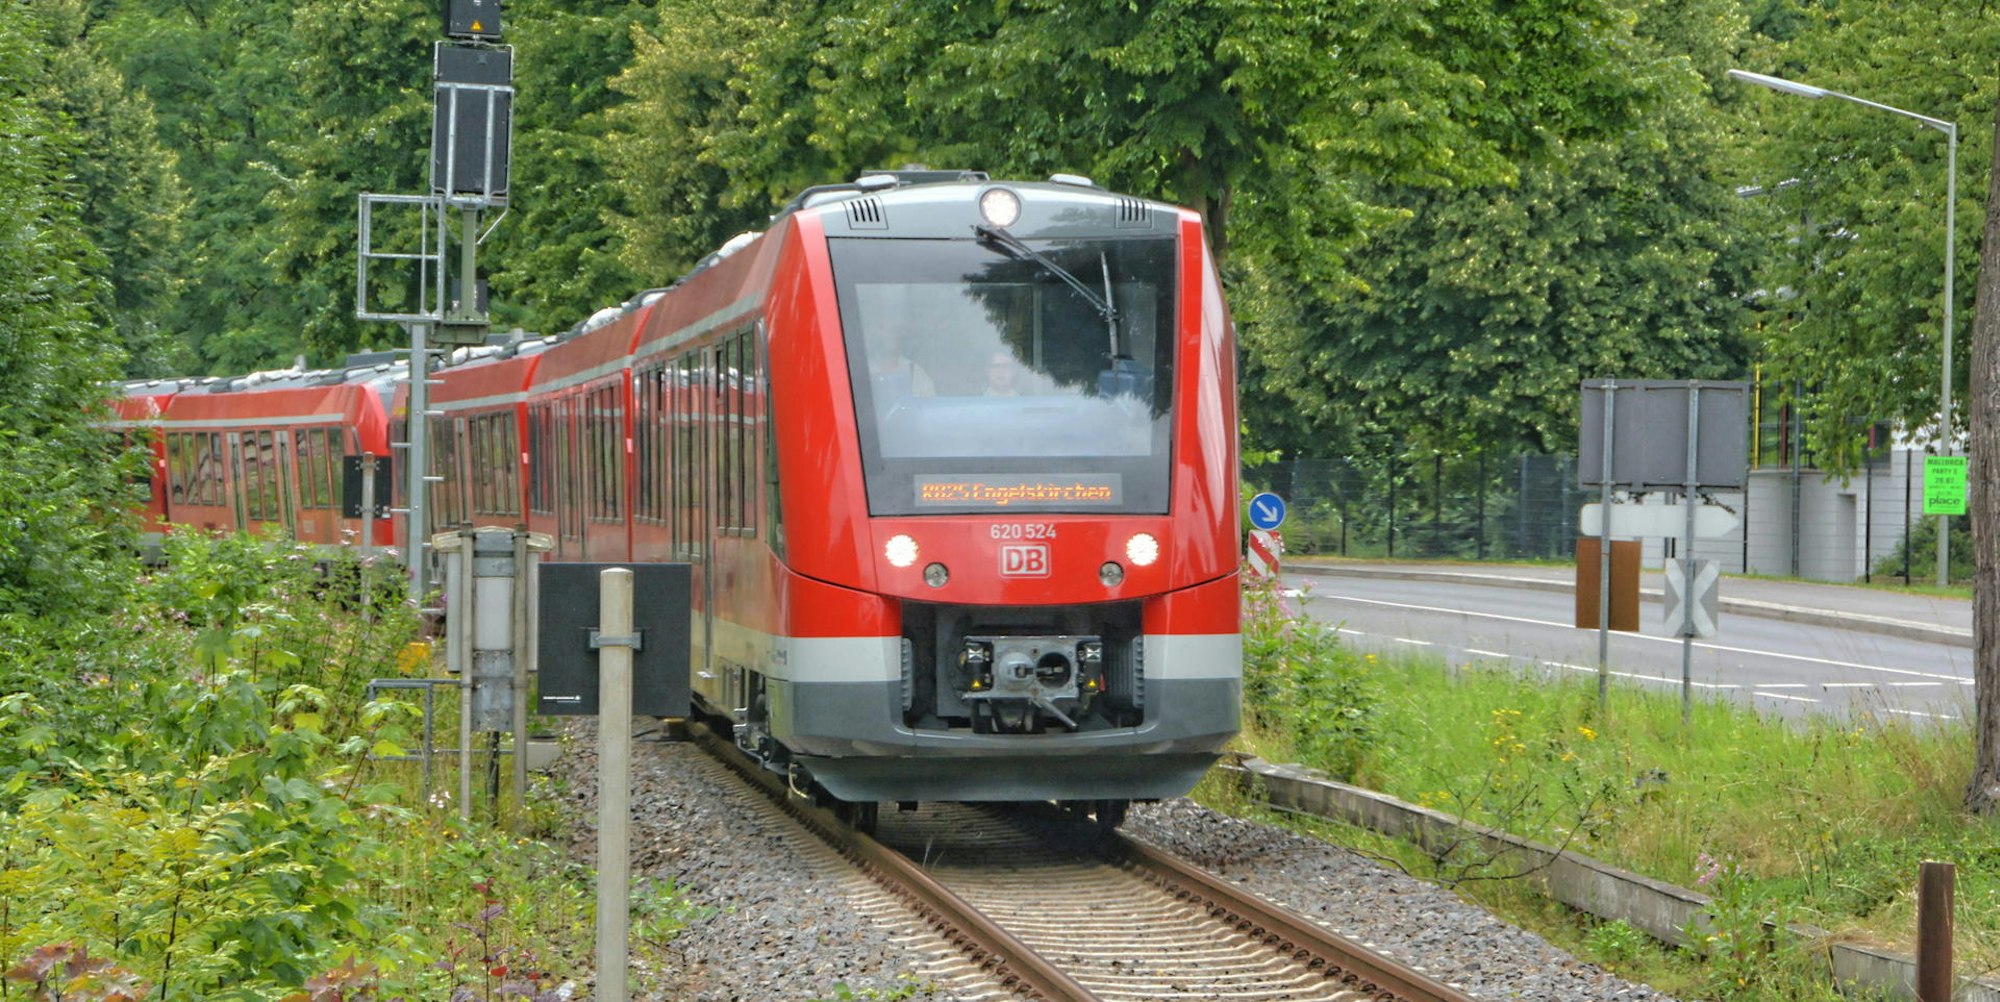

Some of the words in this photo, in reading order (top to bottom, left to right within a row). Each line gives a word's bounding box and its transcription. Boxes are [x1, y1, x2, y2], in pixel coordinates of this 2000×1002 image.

[921, 483, 969, 501] RB25
[973, 483, 1112, 506] Engelskirchen
[1929, 496, 1960, 508] place
[990, 524, 1021, 539] 620
[1026, 524, 1057, 539] 524
[1005, 548, 1044, 571] DB
